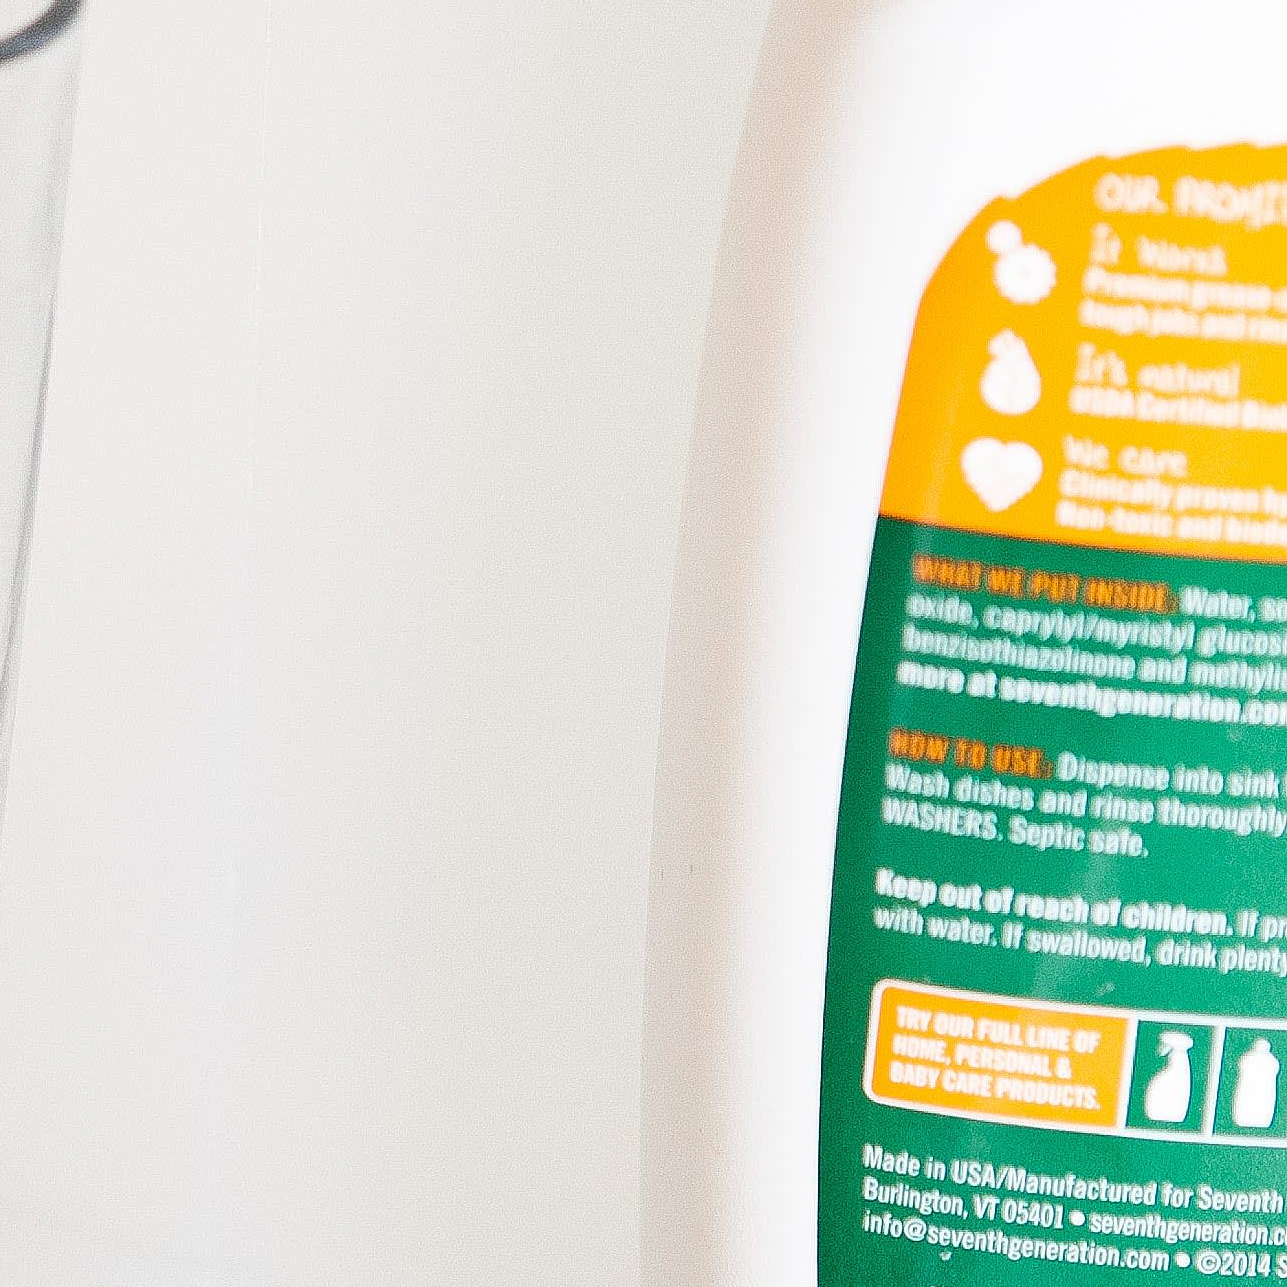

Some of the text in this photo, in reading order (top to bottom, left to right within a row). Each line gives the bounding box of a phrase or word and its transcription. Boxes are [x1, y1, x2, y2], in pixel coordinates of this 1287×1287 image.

[906, 593, 979, 628] oxide,
[1180, 586, 1255, 622] Water,
[897, 661, 964, 693] more
[967, 670, 996, 698] at
[1138, 656, 1187, 684] and
[885, 763, 950, 799] Wash
[953, 775, 1034, 811] dishes
[1038, 788, 1087, 817] and
[1090, 794, 1154, 824] rinse
[1056, 750, 1169, 790] Dispense
[1173, 764, 1223, 795] into
[1227, 767, 1279, 798] sink
[882, 795, 1148, 857] WASHERS. Septic safe.
[875, 867, 937, 908] Keep
[938, 882, 982, 911] out
[984, 886, 1013, 914] of
[1015, 892, 1089, 925] reach
[1091, 897, 1121, 927] of
[1122, 902, 1233, 935] children.
[1236, 910, 1259, 937] If
[873, 906, 924, 936] with
[926, 917, 997, 947] water.
[1002, 921, 1024, 949] If
[1026, 928, 1151, 967] swallowed,
[1156, 938, 1216, 969] drink
[897, 1005, 1101, 1054] TRY OUR FULL LINE OF
[892, 1035, 1072, 1079] HOME, PERSONAL &
[889, 1061, 1101, 1111] BABY CARE PRODUCTS.
[864, 1144, 1284, 1213] Made in USA/Manufactured for Seventh
[864, 1177, 969, 1220] Burlington,
[973, 1196, 1001, 1221] VT
[1003, 1199, 1065, 1229] 05401
[864, 1210, 1169, 1271] info@seventhgeneration.com
